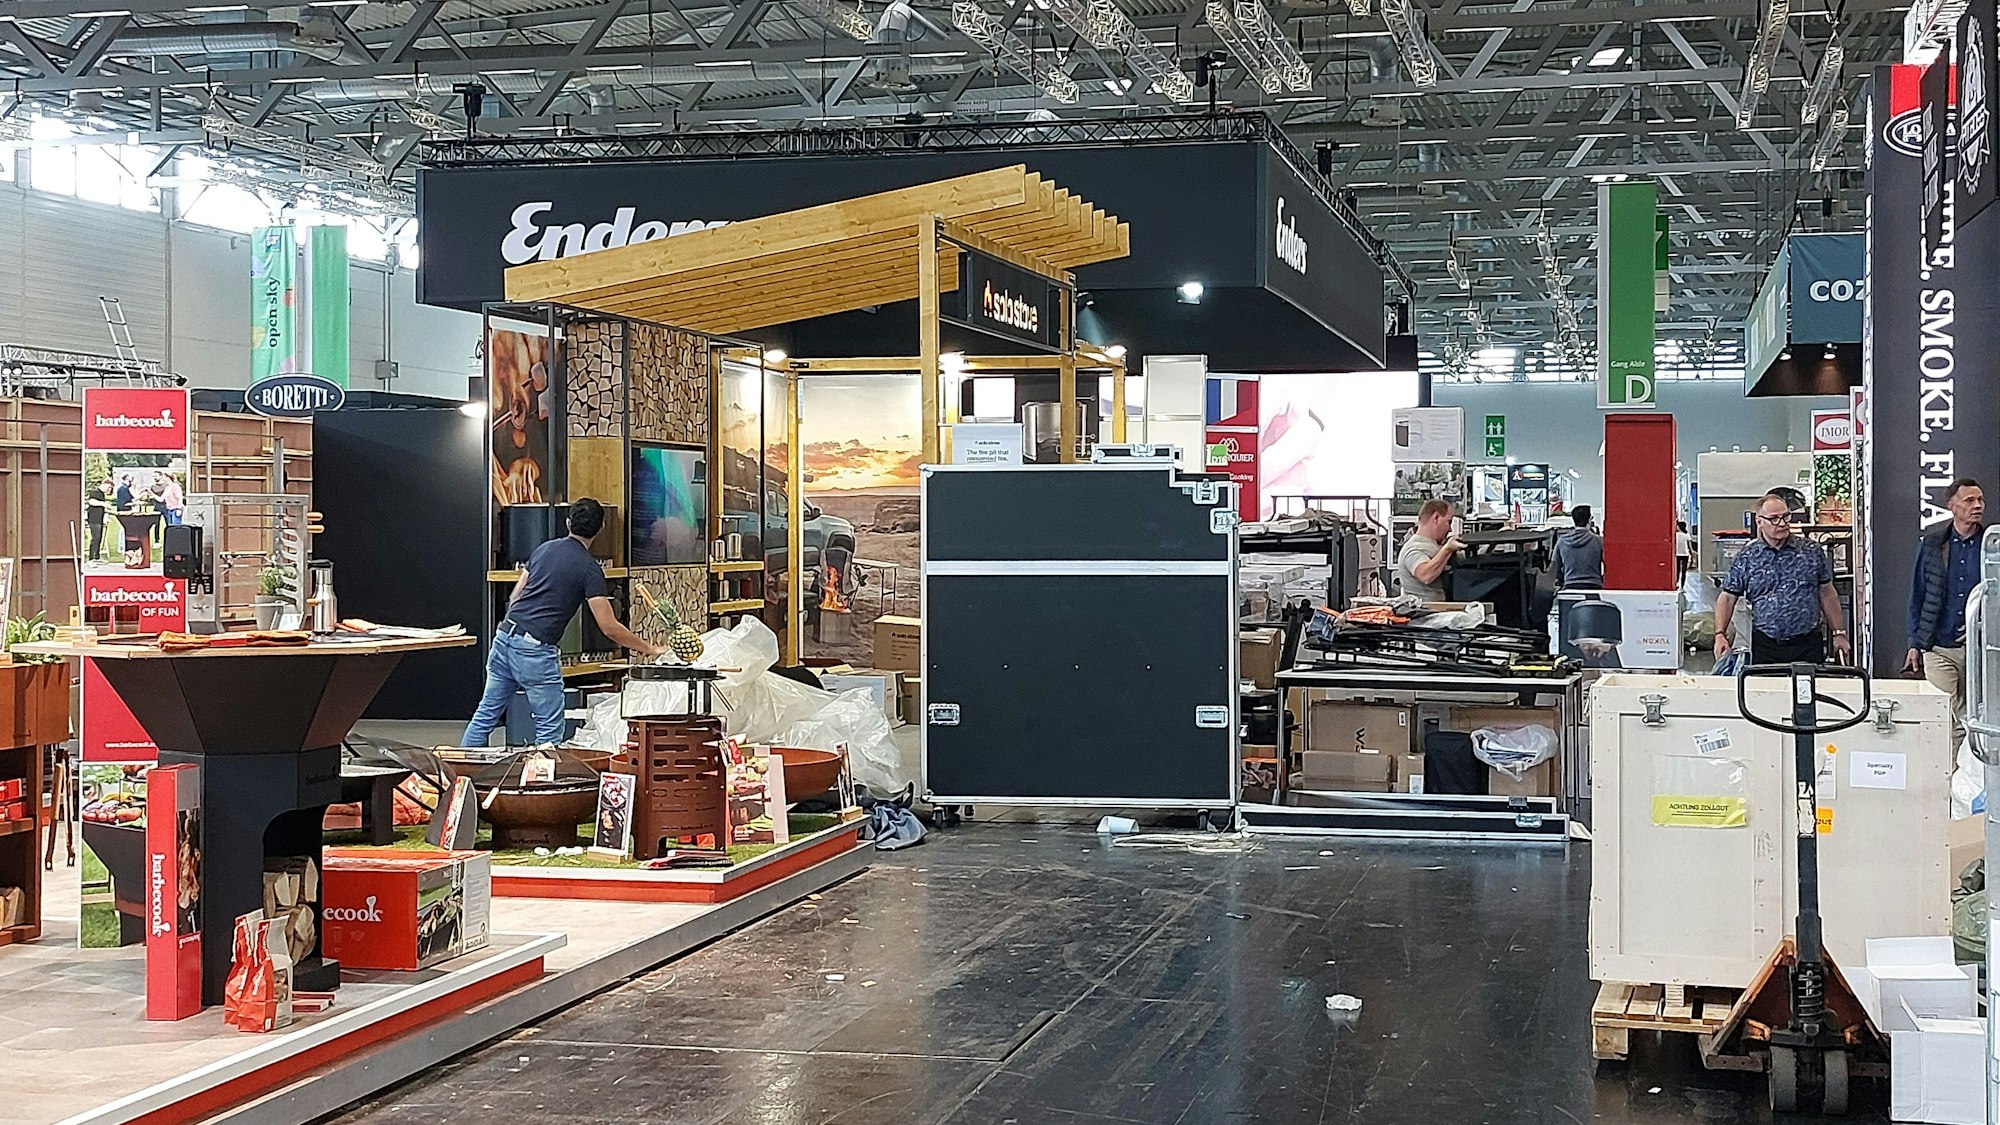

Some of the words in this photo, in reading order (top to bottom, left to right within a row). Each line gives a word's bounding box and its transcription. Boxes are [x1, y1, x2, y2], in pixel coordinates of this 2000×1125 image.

[266, 277, 281, 305] sky
[269, 307, 281, 348] open
[1918, 289, 1956, 443] SMOKE.
[261, 384, 328, 410] BORETTI
[1625, 374, 1652, 403] D
[95, 409, 176, 428] barbecook
[90, 581, 181, 603] barbecook
[141, 607, 157, 617] OF
[158, 607, 179, 617] FUN
[152, 853, 172, 938] barbecook
[322, 895, 384, 922] ecook
